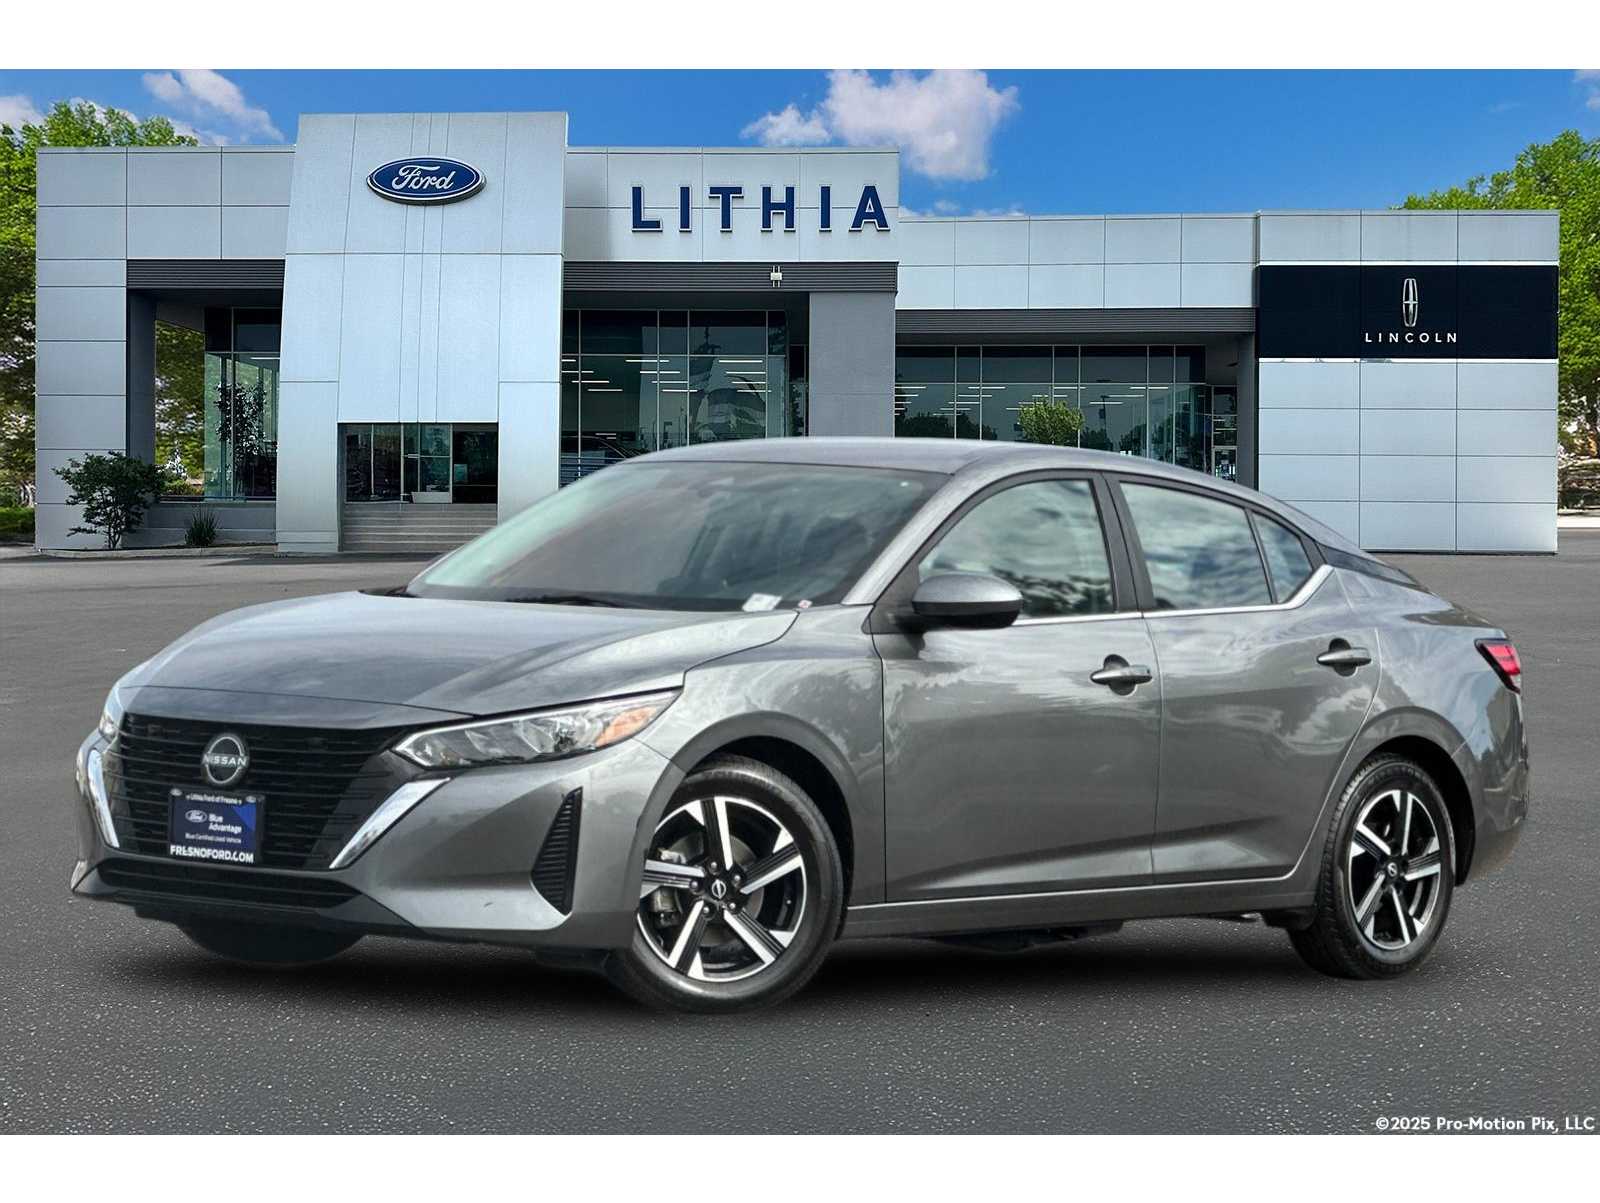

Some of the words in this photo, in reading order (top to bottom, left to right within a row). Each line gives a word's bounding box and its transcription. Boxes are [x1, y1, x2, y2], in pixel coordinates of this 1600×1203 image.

[391, 164, 456, 190] Ford
[631, 185, 891, 233] LITHIA
[1365, 332, 1457, 343] LINCOLN
[202, 754, 248, 767] NISSAN
[208, 813, 224, 823] Blue
[208, 823, 242, 834] Advantage
